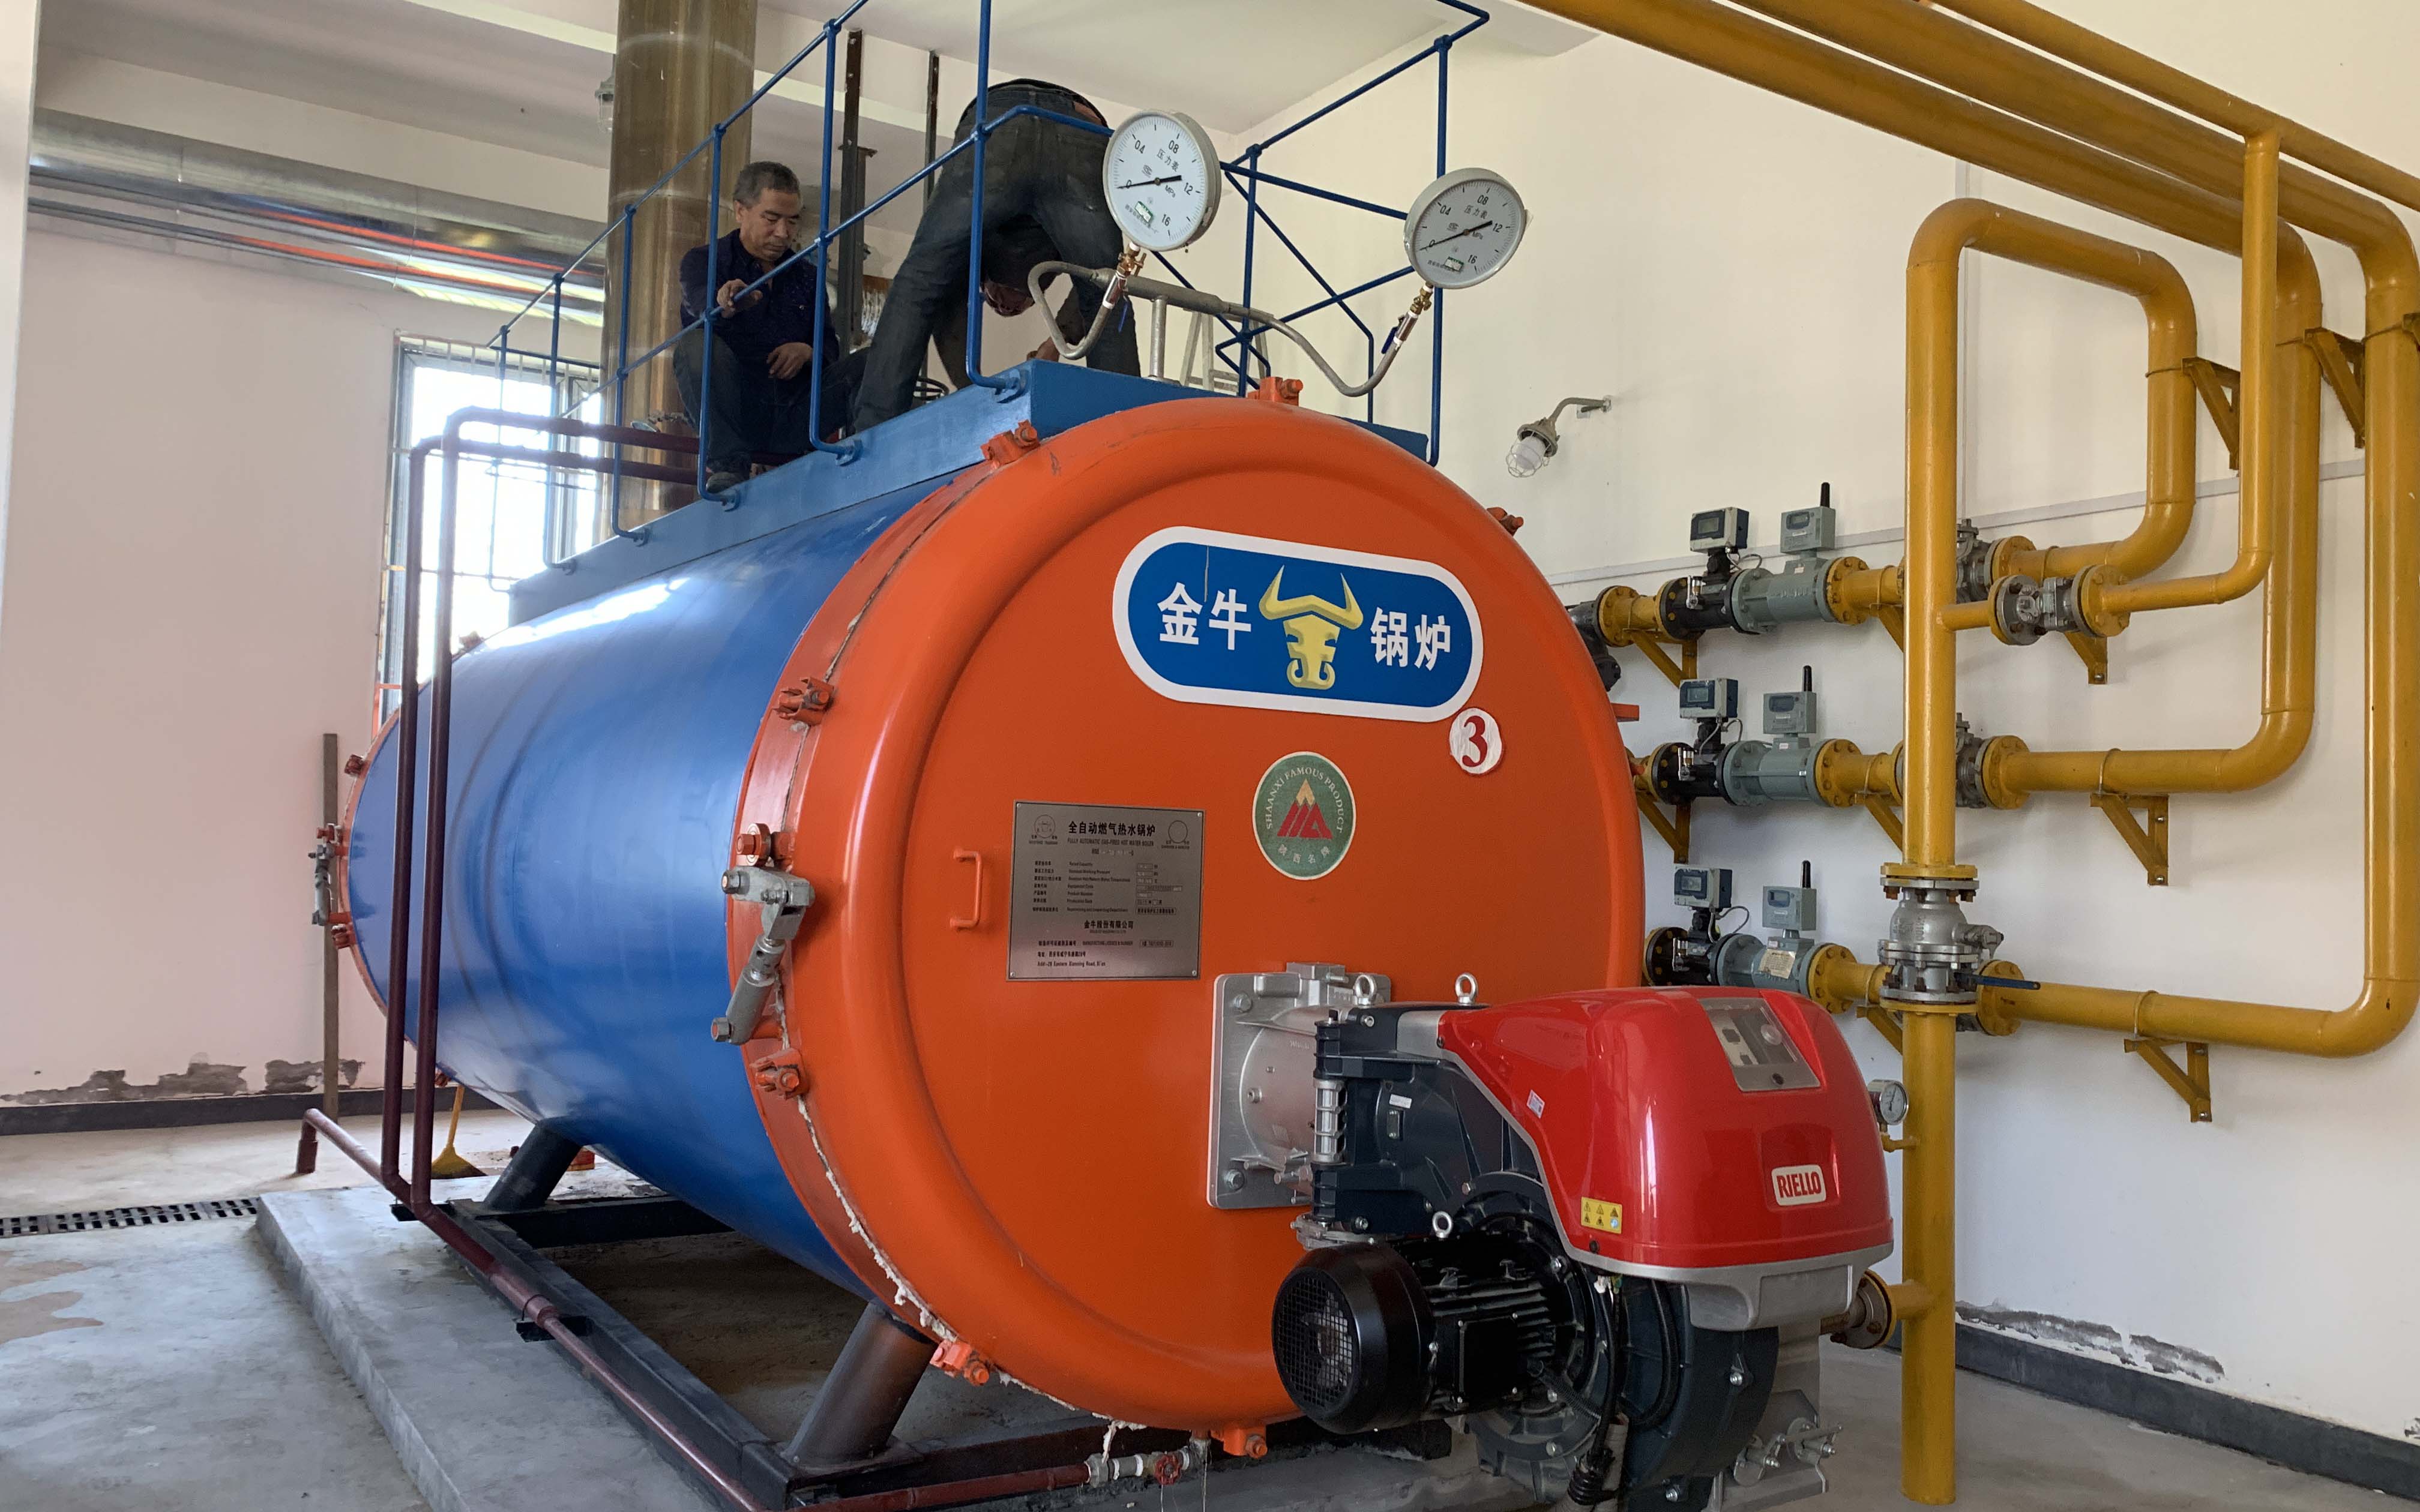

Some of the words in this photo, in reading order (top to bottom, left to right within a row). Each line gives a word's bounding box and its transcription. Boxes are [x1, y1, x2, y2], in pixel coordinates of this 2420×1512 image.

[1157, 581, 1252, 650] 金牛
[1370, 607, 1451, 670] 锅炉
[1461, 715, 1488, 768] 3
[1265, 777, 1286, 830] SHAANXI
[1284, 767, 1325, 781] FAMOUS
[1324, 776, 1344, 833] PRODUCT
[1068, 820, 1156, 837] 全自动燃气热水锅炉
[1084, 920, 1134, 929] 金牛股份有限公司
[1776, 1171, 1822, 1199] RIELLO
